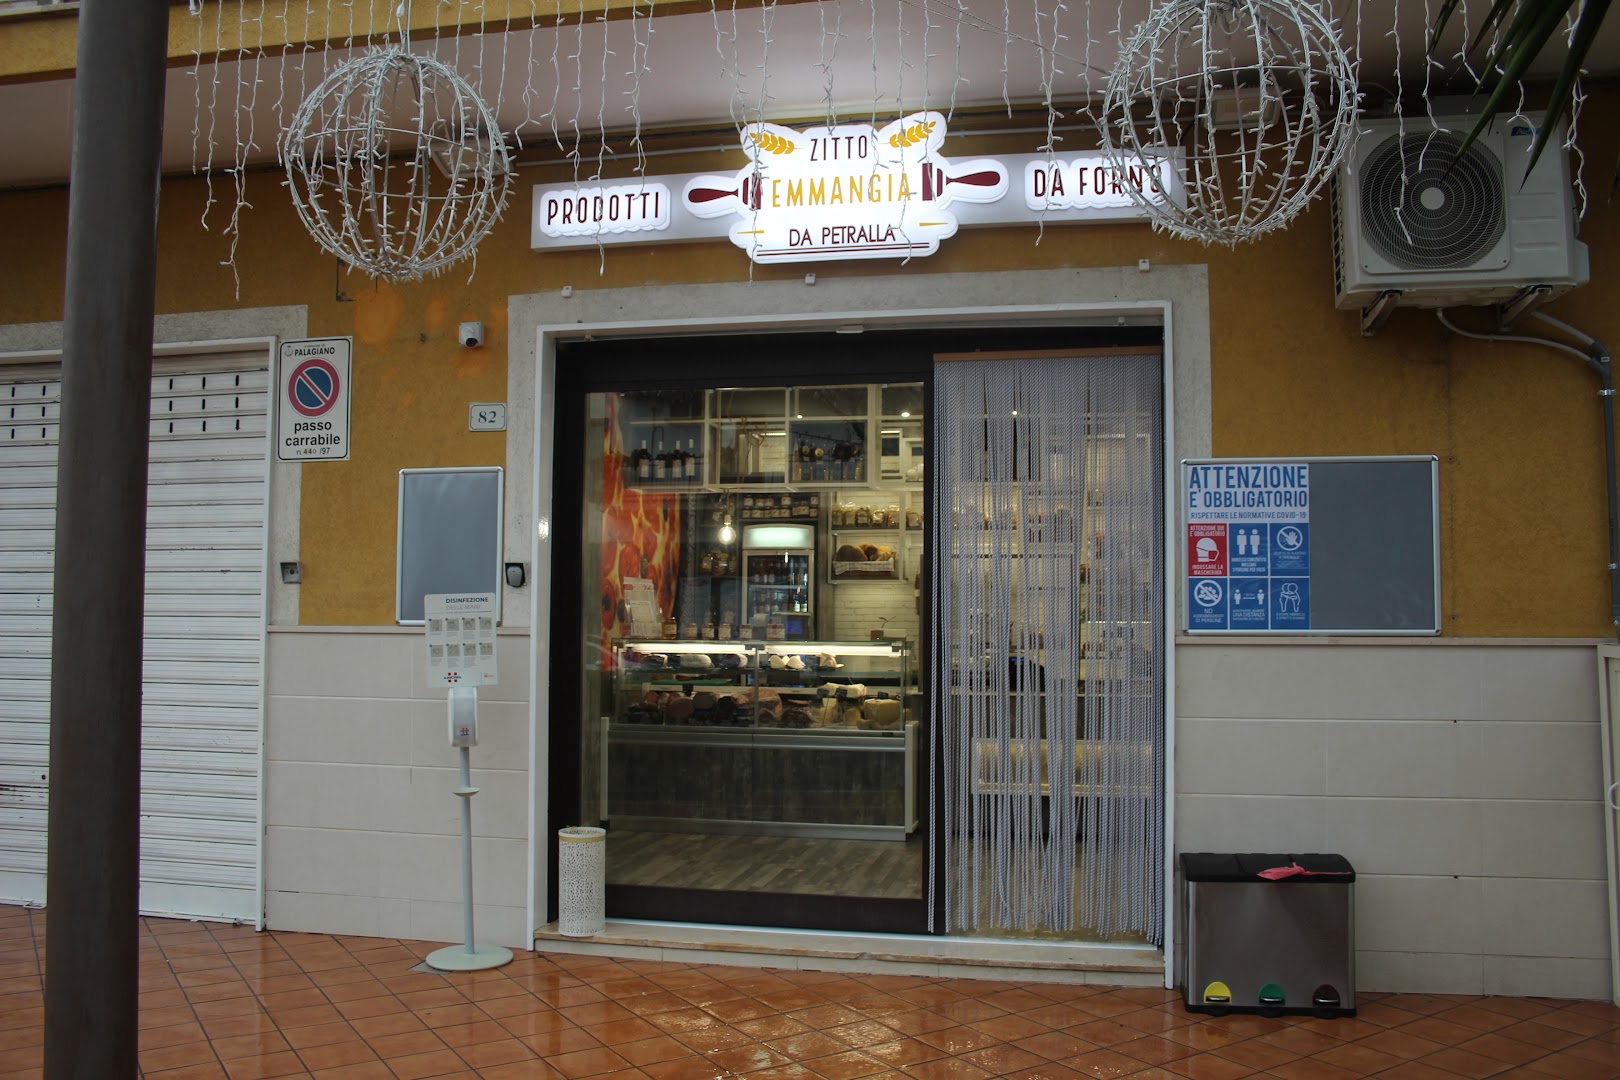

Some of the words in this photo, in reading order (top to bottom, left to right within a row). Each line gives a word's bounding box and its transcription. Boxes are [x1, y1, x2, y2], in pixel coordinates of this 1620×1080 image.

[810, 135, 868, 162] ZITTO
[771, 173, 912, 208] EMMANGIA
[1034, 168, 1065, 198] DA
[547, 191, 660, 226] PRODOTTI
[789, 228, 813, 247] DA
[821, 223, 897, 245] PETRALLA
[294, 347, 336, 357] PALAGIANO
[478, 410, 497, 424] 82
[294, 421, 332, 435] passo
[285, 433, 341, 447] carrabile
[1189, 465, 1308, 489] ATTENZIONE
[1238, 511, 1275, 519] NORMATIVE
[1276, 511, 1307, 519] COVID-19
[445, 596, 489, 604] DISINFEZIONE
